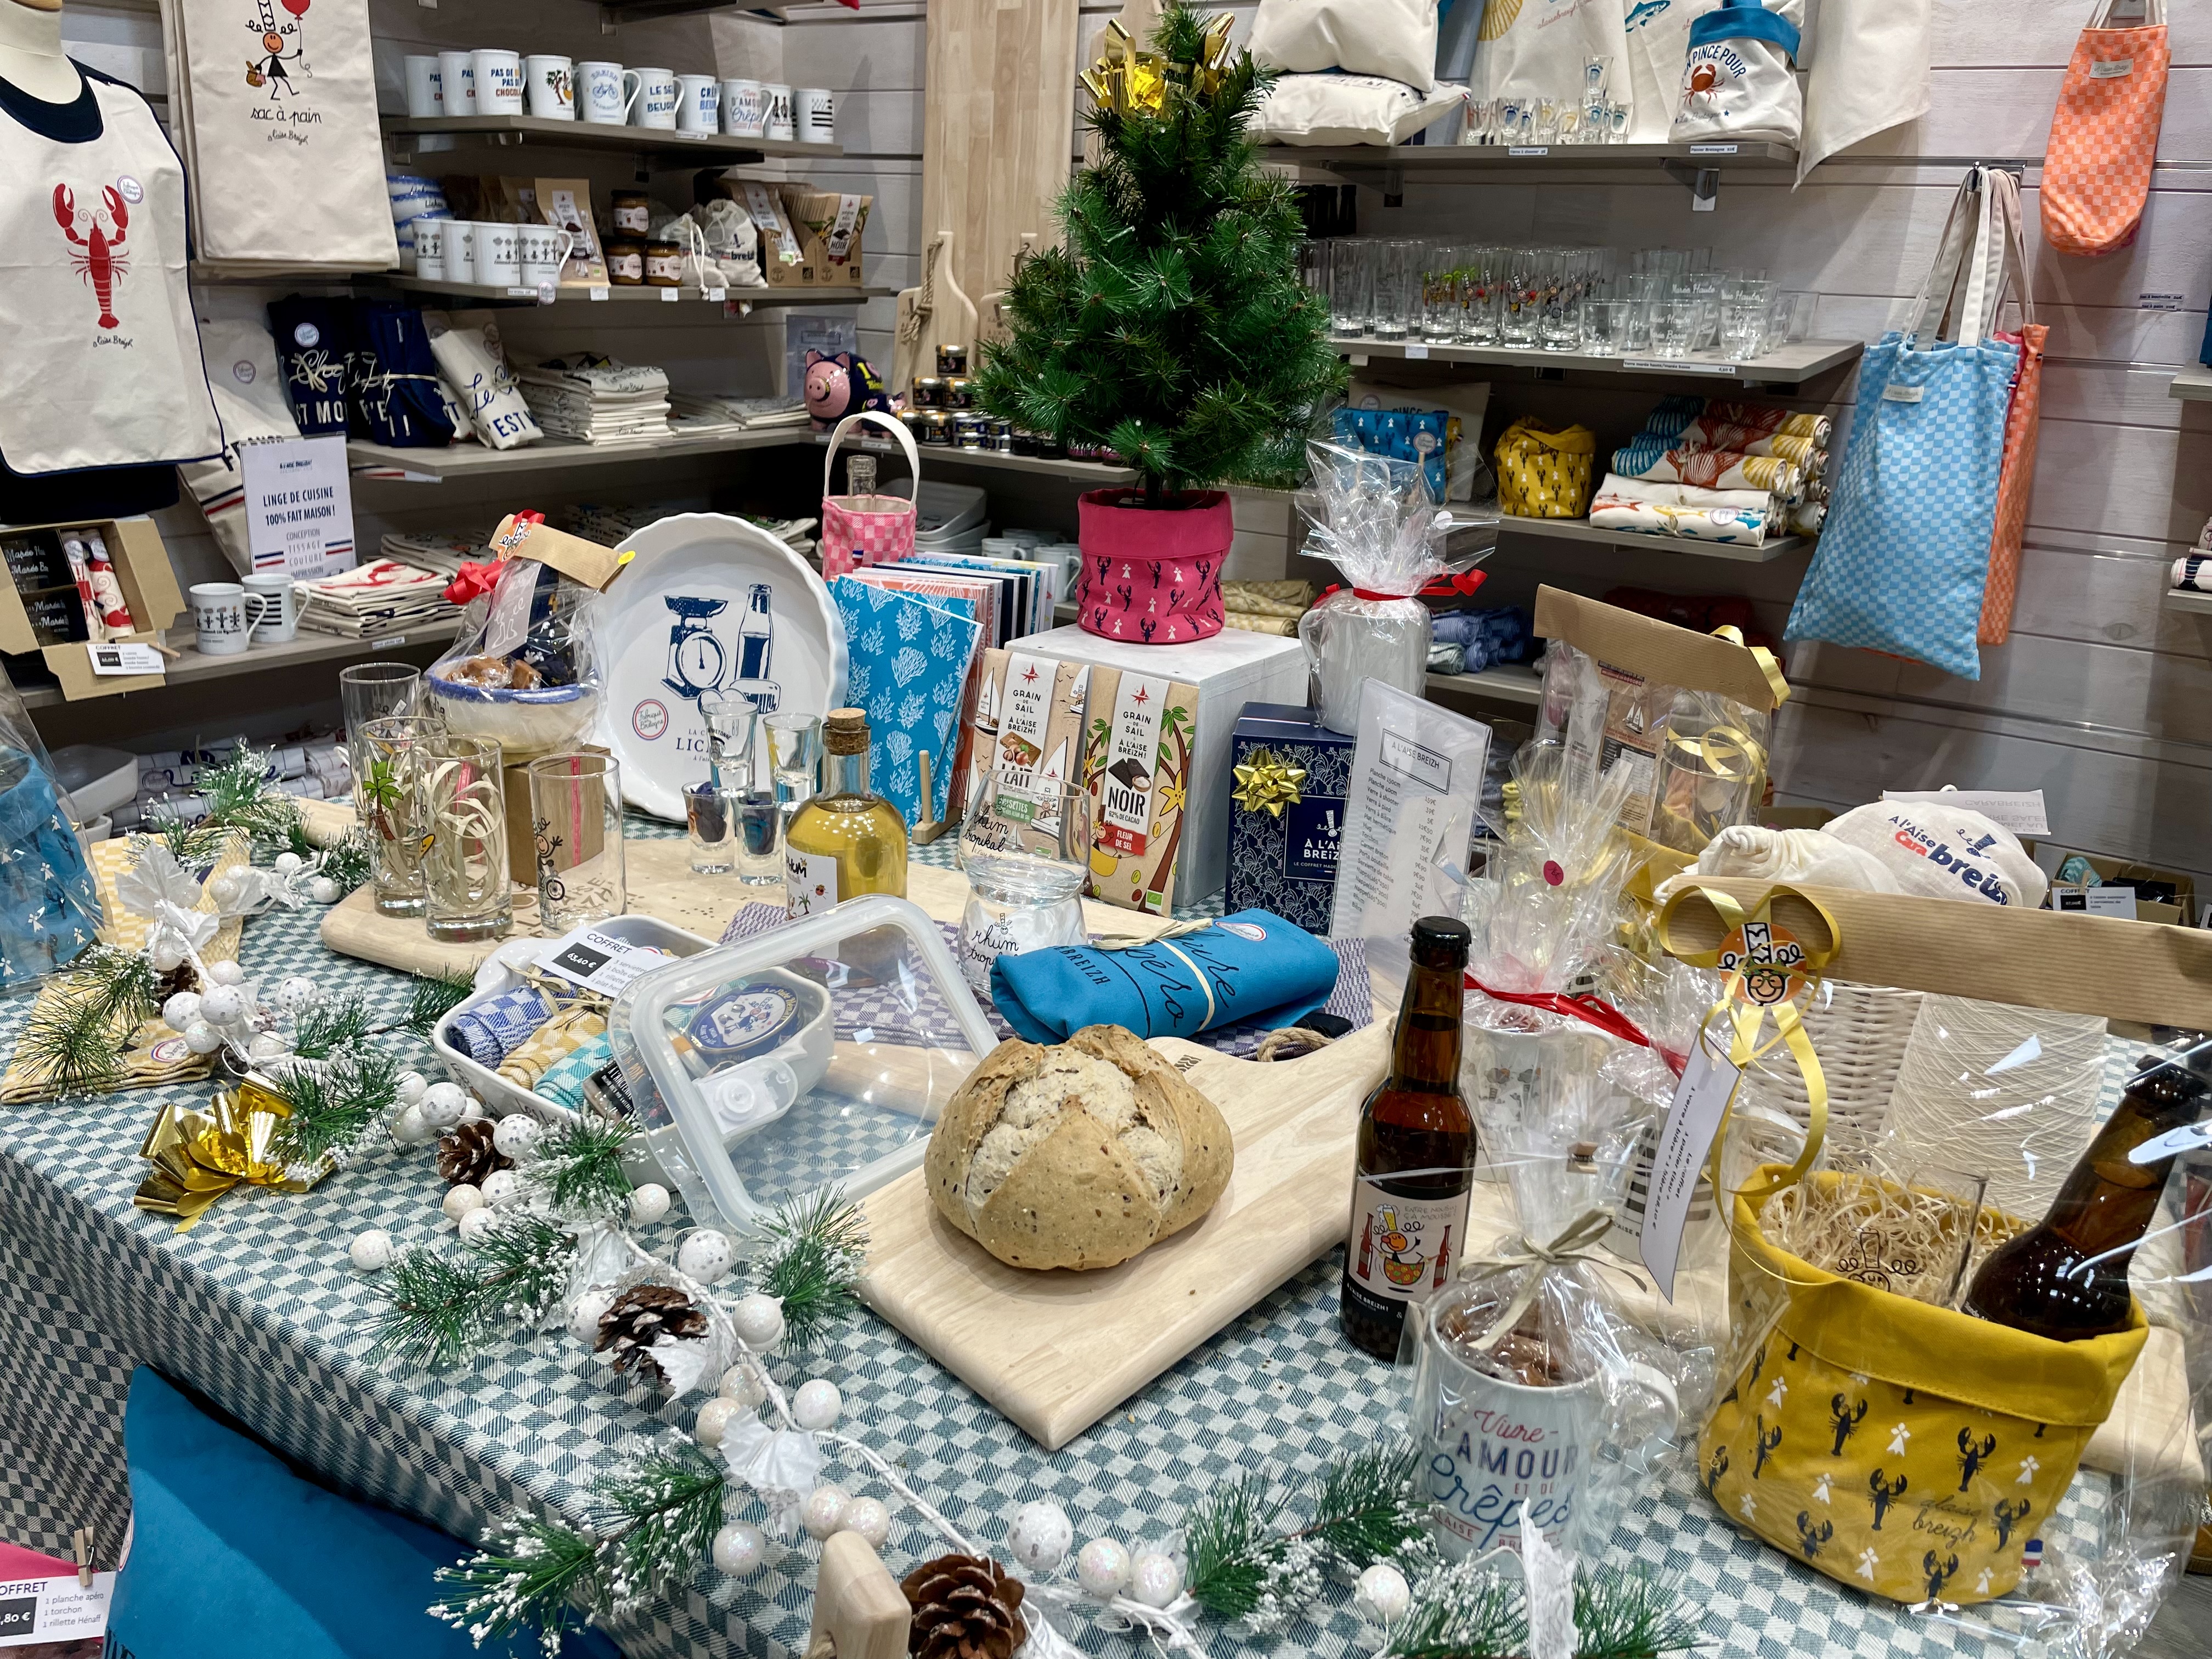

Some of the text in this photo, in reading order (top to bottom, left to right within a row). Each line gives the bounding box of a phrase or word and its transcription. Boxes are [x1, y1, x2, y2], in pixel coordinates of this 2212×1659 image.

[1692, 45, 1746, 79] PINCE POUR
[491, 69, 504, 77] PAS
[250, 105, 322, 127] sac à pain
[263, 486, 334, 507] LINGE DE CUISINE
[266, 506, 331, 527] 100% FAIT MAISON
[286, 528, 320, 541] CONCEPTION
[289, 541, 320, 554] TISSAGE
[289, 553, 323, 567] COUTURE
[291, 566, 324, 578] IMPRESSION
[1013, 689, 1041, 702] GRAIN
[1015, 703, 1034, 713] SAIL
[1123, 711, 1151, 725] GRAIN
[1125, 726, 1144, 737] SAIL
[1397, 744, 1417, 759] L'AISE
[1417, 752, 1440, 769] BREIZH
[1001, 763, 1032, 788] LAIT
[1367, 786, 1378, 796] Verre
[1383, 794, 1399, 806] shooter
[1368, 777, 1435, 815] Planche 40cm 39€
[1370, 768, 1436, 806] Planche 150cm 159€
[1108, 786, 1146, 817] NOIR
[969, 805, 1008, 834] rhum
[1109, 810, 1140, 825] 62% DE CACAO
[1365, 804, 1376, 815] Verre
[1420, 834, 1432, 845] 7€90
[1366, 795, 1377, 805] Verre
[1381, 803, 1391, 813] pied
[1419, 823, 1433, 835] 12€50
[963, 830, 1005, 853] tropikal
[1117, 830, 1133, 841] FLEUR
[1364, 813, 1429, 854] Plat hermétique 35€
[1888, 815, 1936, 848] A l'Aise
[1115, 839, 1132, 851] DE SEL
[1362, 831, 1427, 872] Torchon 9€90
[1363, 822, 1428, 863] Mug 12€
[1895, 831, 1928, 856] Cara
[1359, 849, 1424, 891] Porte bouteille 24€
[1360, 840, 1425, 882] Carnet Breton 9€90
[1357, 858, 1423, 900] Serviette de table 7€50
[1353, 893, 1365, 904] Rhum
[1412, 900, 1421, 910] 84€
[586, 933, 632, 954] COFFRET
[972, 925, 1019, 952] rhum
[567, 952, 588, 966] 63,40
[619, 961, 648, 973] serviettes
[605, 974, 625, 985] rillette
[611, 967, 628, 977] boîte
[595, 979, 609, 989] plat
[1680, 1094, 1692, 1118] verre
[1671, 1127, 1681, 1152] bière
[1674, 1138, 1686, 1169] panier
[1686, 1153, 1692, 1164] Le
[1659, 1169, 1668, 1193] bière
[1668, 1171, 1677, 1193] tissu
[1474, 1410, 1544, 1442] Vivre
[1515, 1483, 1554, 1494] ET DE
[0, 1582, 48, 1595] OFFRET
[52, 1594, 83, 1605] planche
[86, 1592, 104, 1601] apéro
[21, 1612, 31, 1621] €
[49, 1618, 76, 1627] rillette
[78, 1614, 101, 1624] Hénaff
[51, 1606, 82, 1616] torchon
